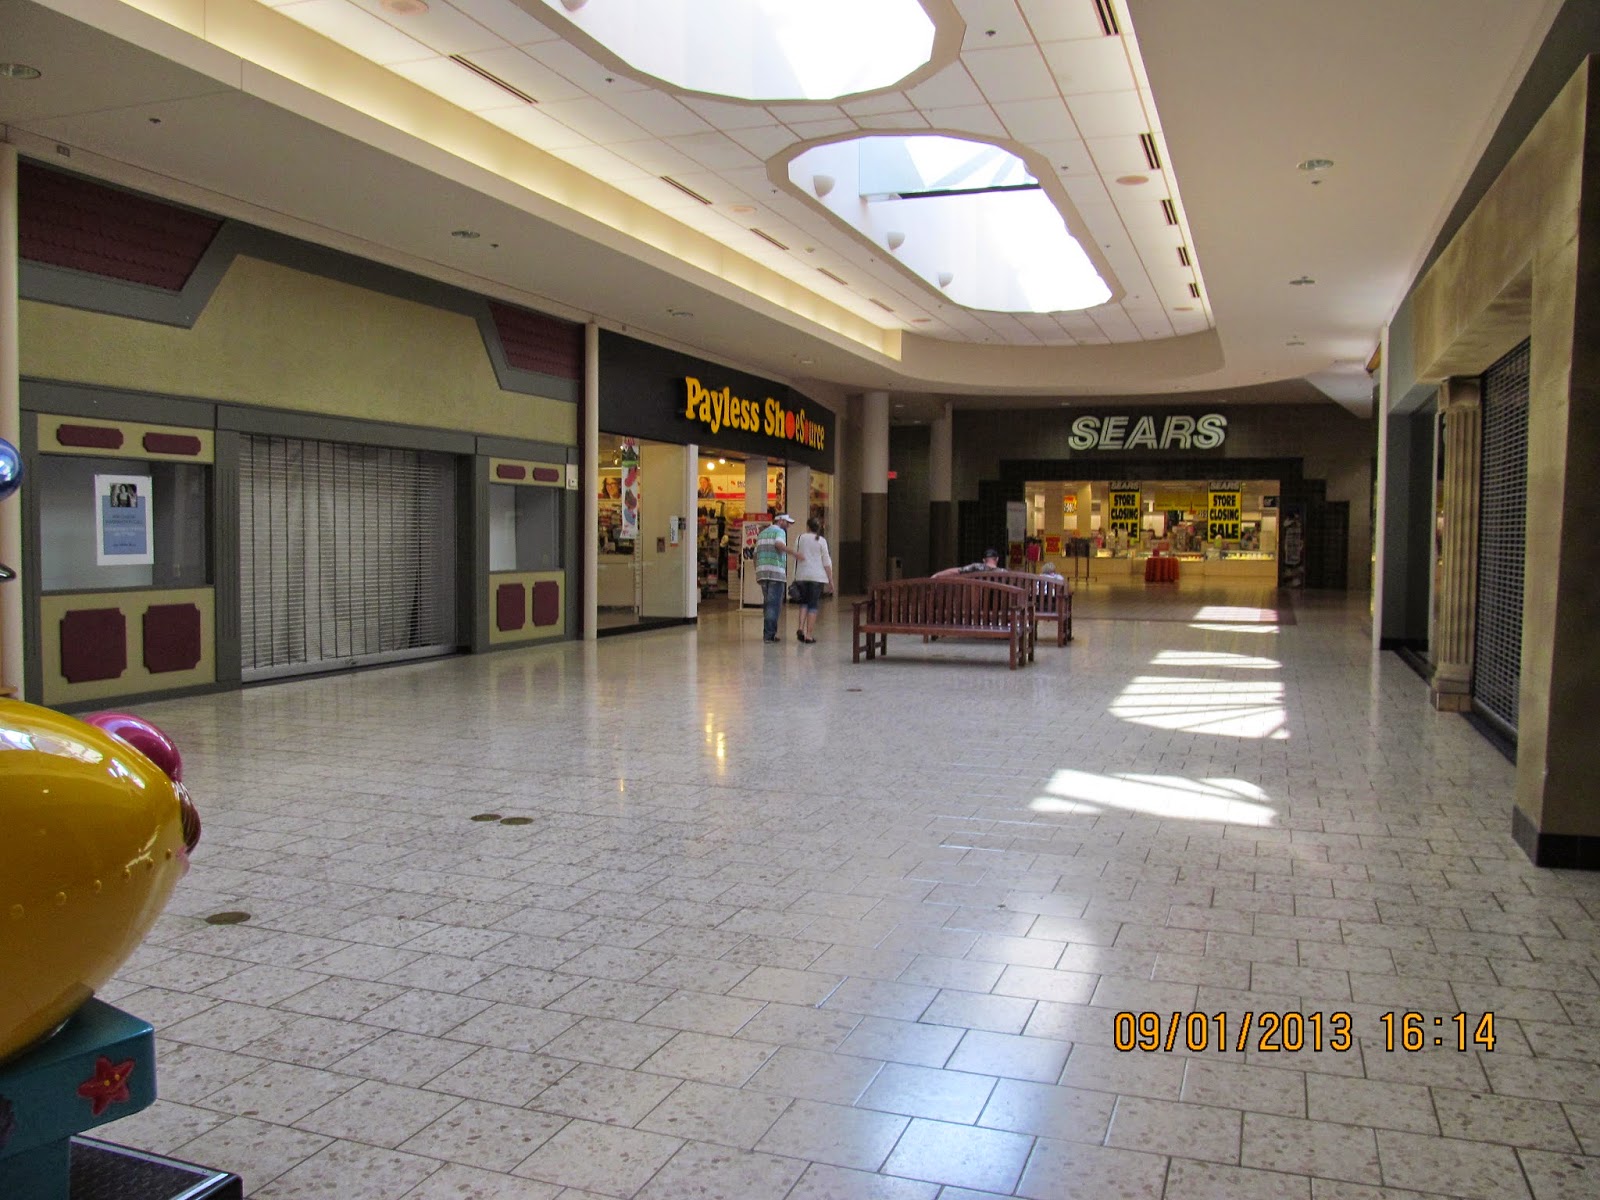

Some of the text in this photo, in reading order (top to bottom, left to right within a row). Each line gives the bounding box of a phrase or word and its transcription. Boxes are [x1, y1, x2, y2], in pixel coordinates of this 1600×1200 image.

[685, 375, 825, 451] Payless ShoeSource
[1068, 413, 1228, 450] SEARS
[1110, 481, 1139, 490] SEARS
[1209, 480, 1240, 490] SEARS
[1113, 494, 1136, 506] STORE
[1213, 494, 1236, 507] STORE
[1110, 508, 1139, 520] CLOSING
[1209, 508, 1239, 520] CLOSING
[1209, 523, 1239, 539] SALE
